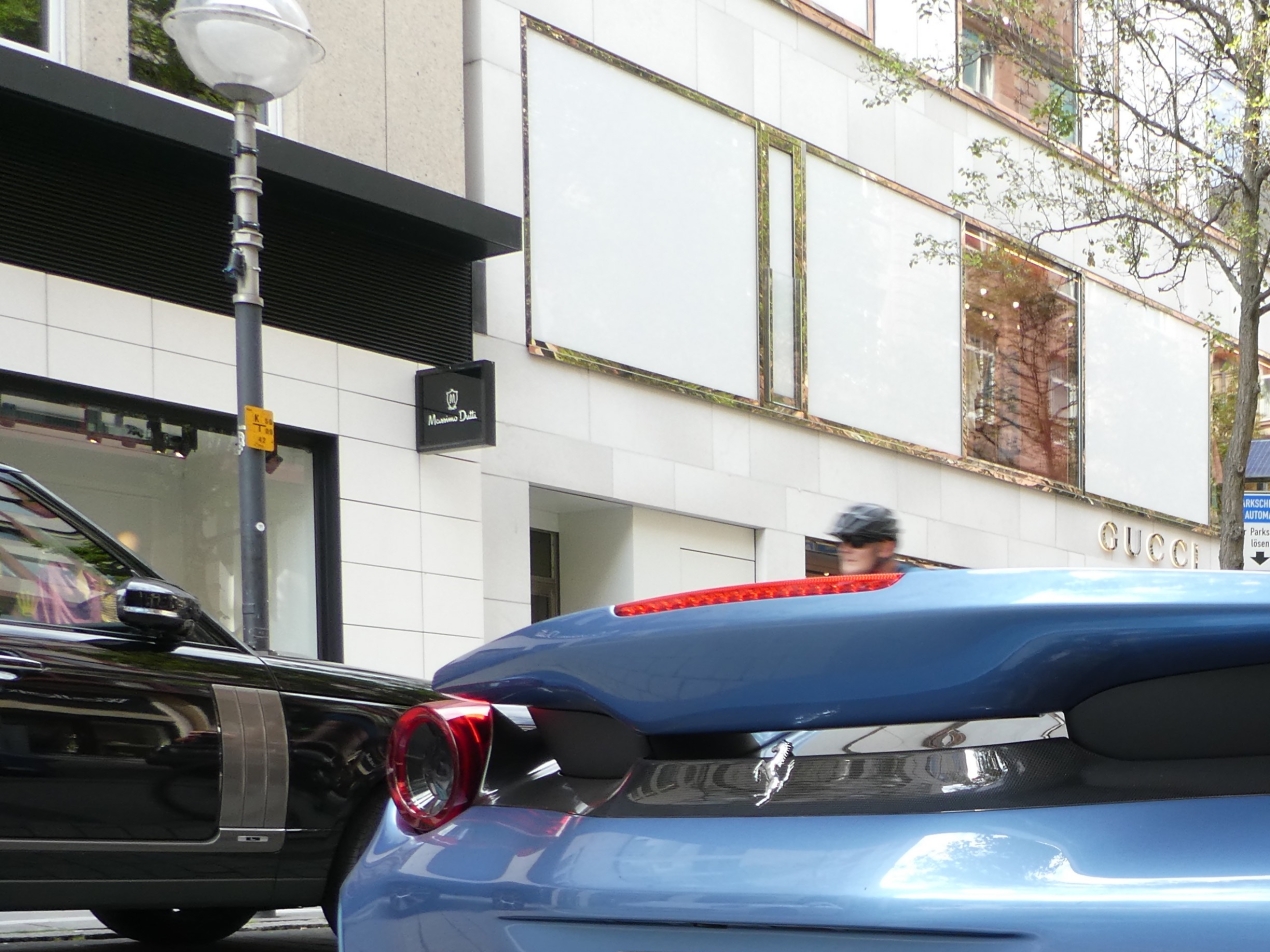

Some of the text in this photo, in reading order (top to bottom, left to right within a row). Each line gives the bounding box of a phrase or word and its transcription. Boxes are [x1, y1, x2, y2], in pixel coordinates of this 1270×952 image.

[427, 409, 478, 427] Massimo Dutti
[1097, 519, 1199, 569] GUCCI
[1250, 538, 1270, 548] lösen
